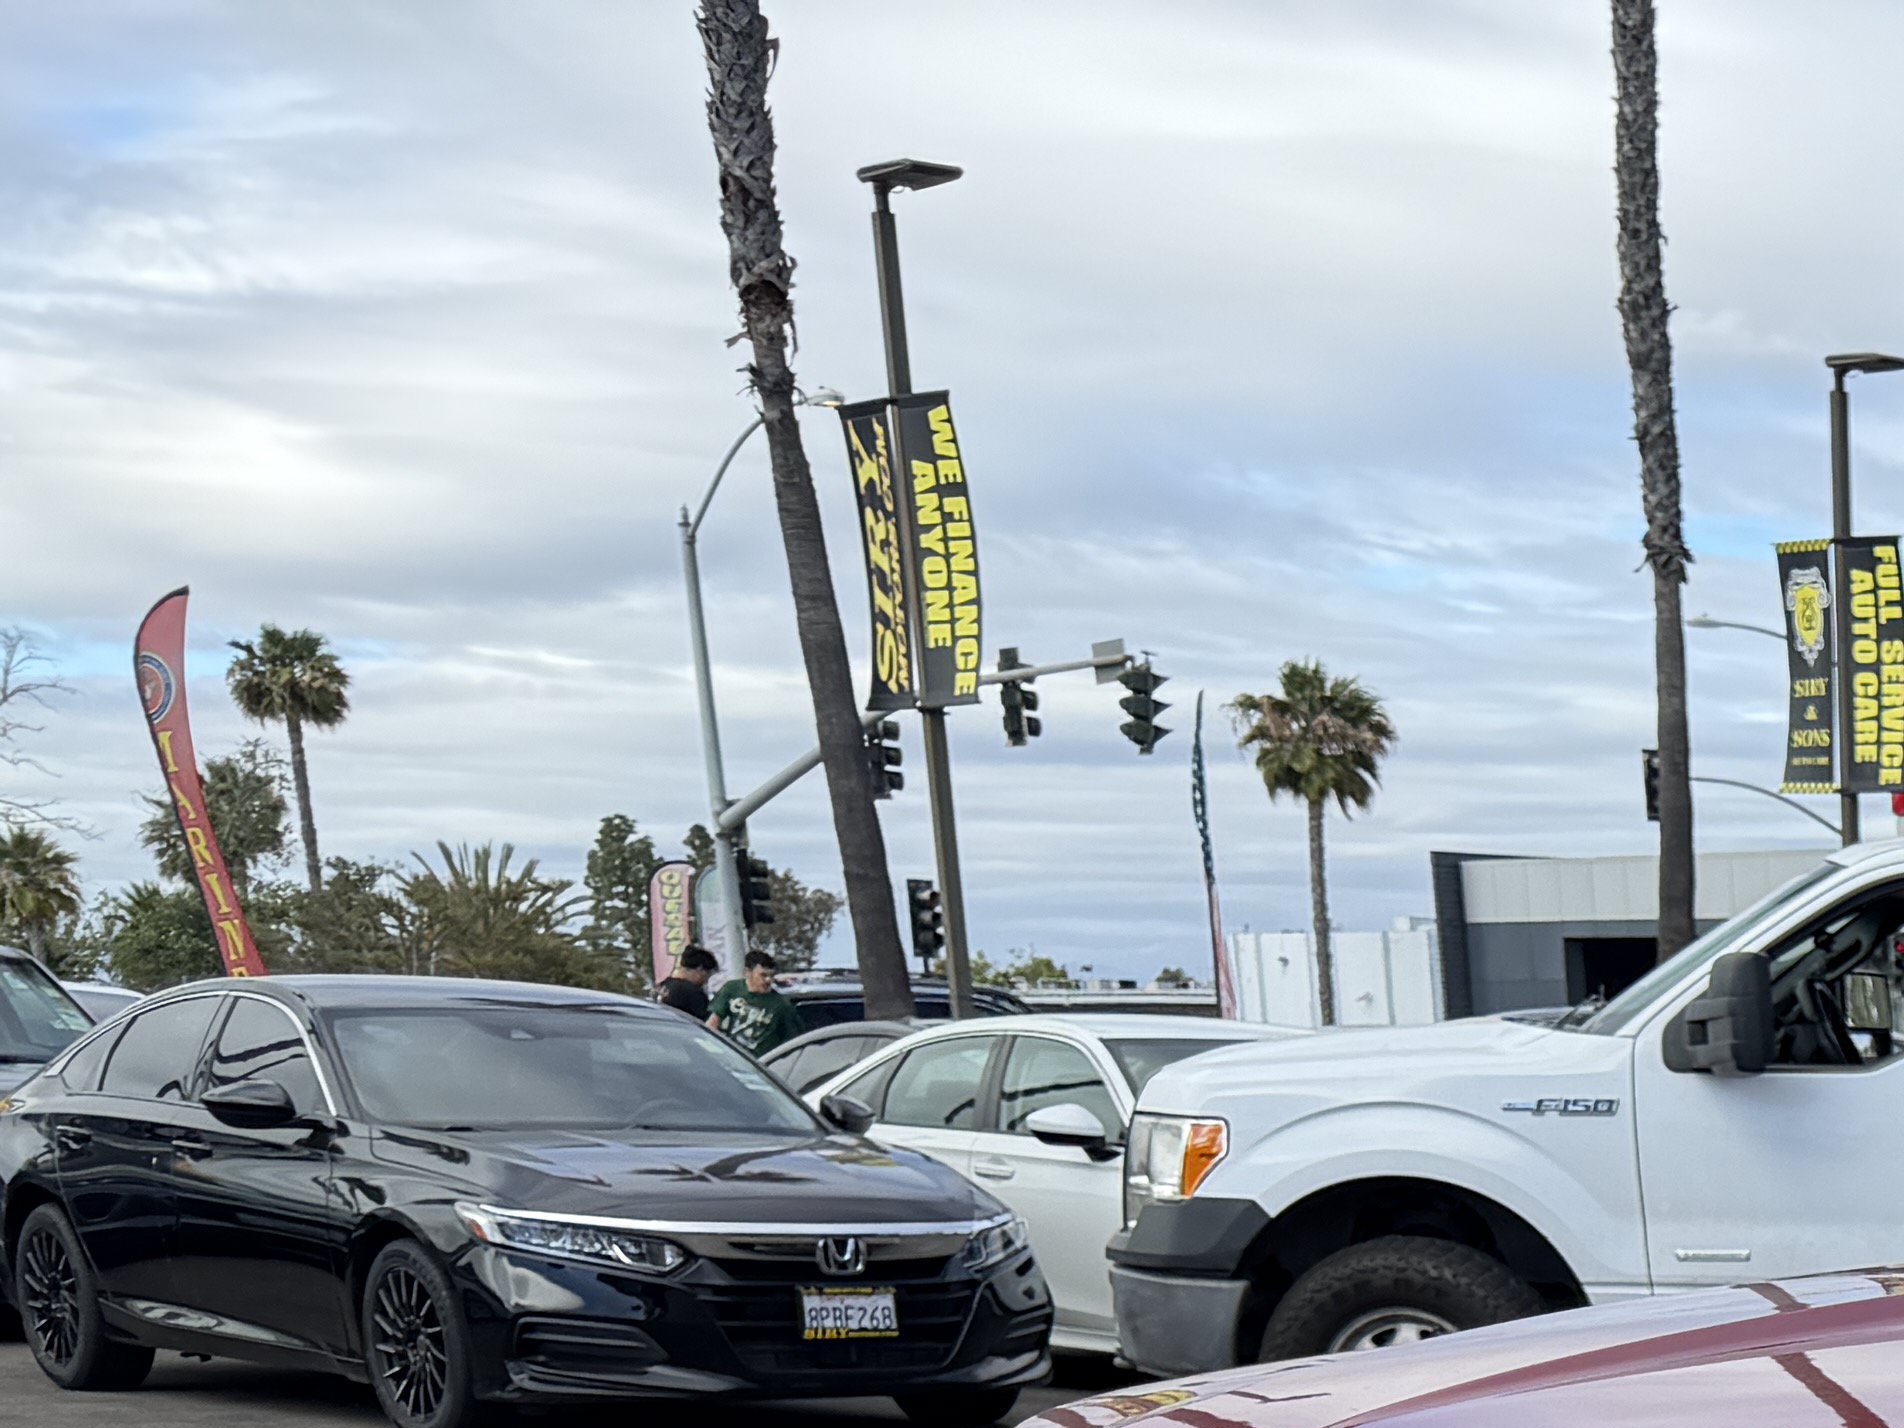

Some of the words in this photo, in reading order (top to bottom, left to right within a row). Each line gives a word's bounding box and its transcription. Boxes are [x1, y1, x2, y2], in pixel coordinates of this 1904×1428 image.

[928, 404, 964, 484] WE
[848, 419, 899, 694] SIRY
[910, 460, 952, 649] ANYONE
[943, 496, 979, 697] FINANCE
[1873, 545, 1903, 625] FULL
[1850, 569, 1878, 664] AUTO
[1853, 672, 1879, 763] CARE
